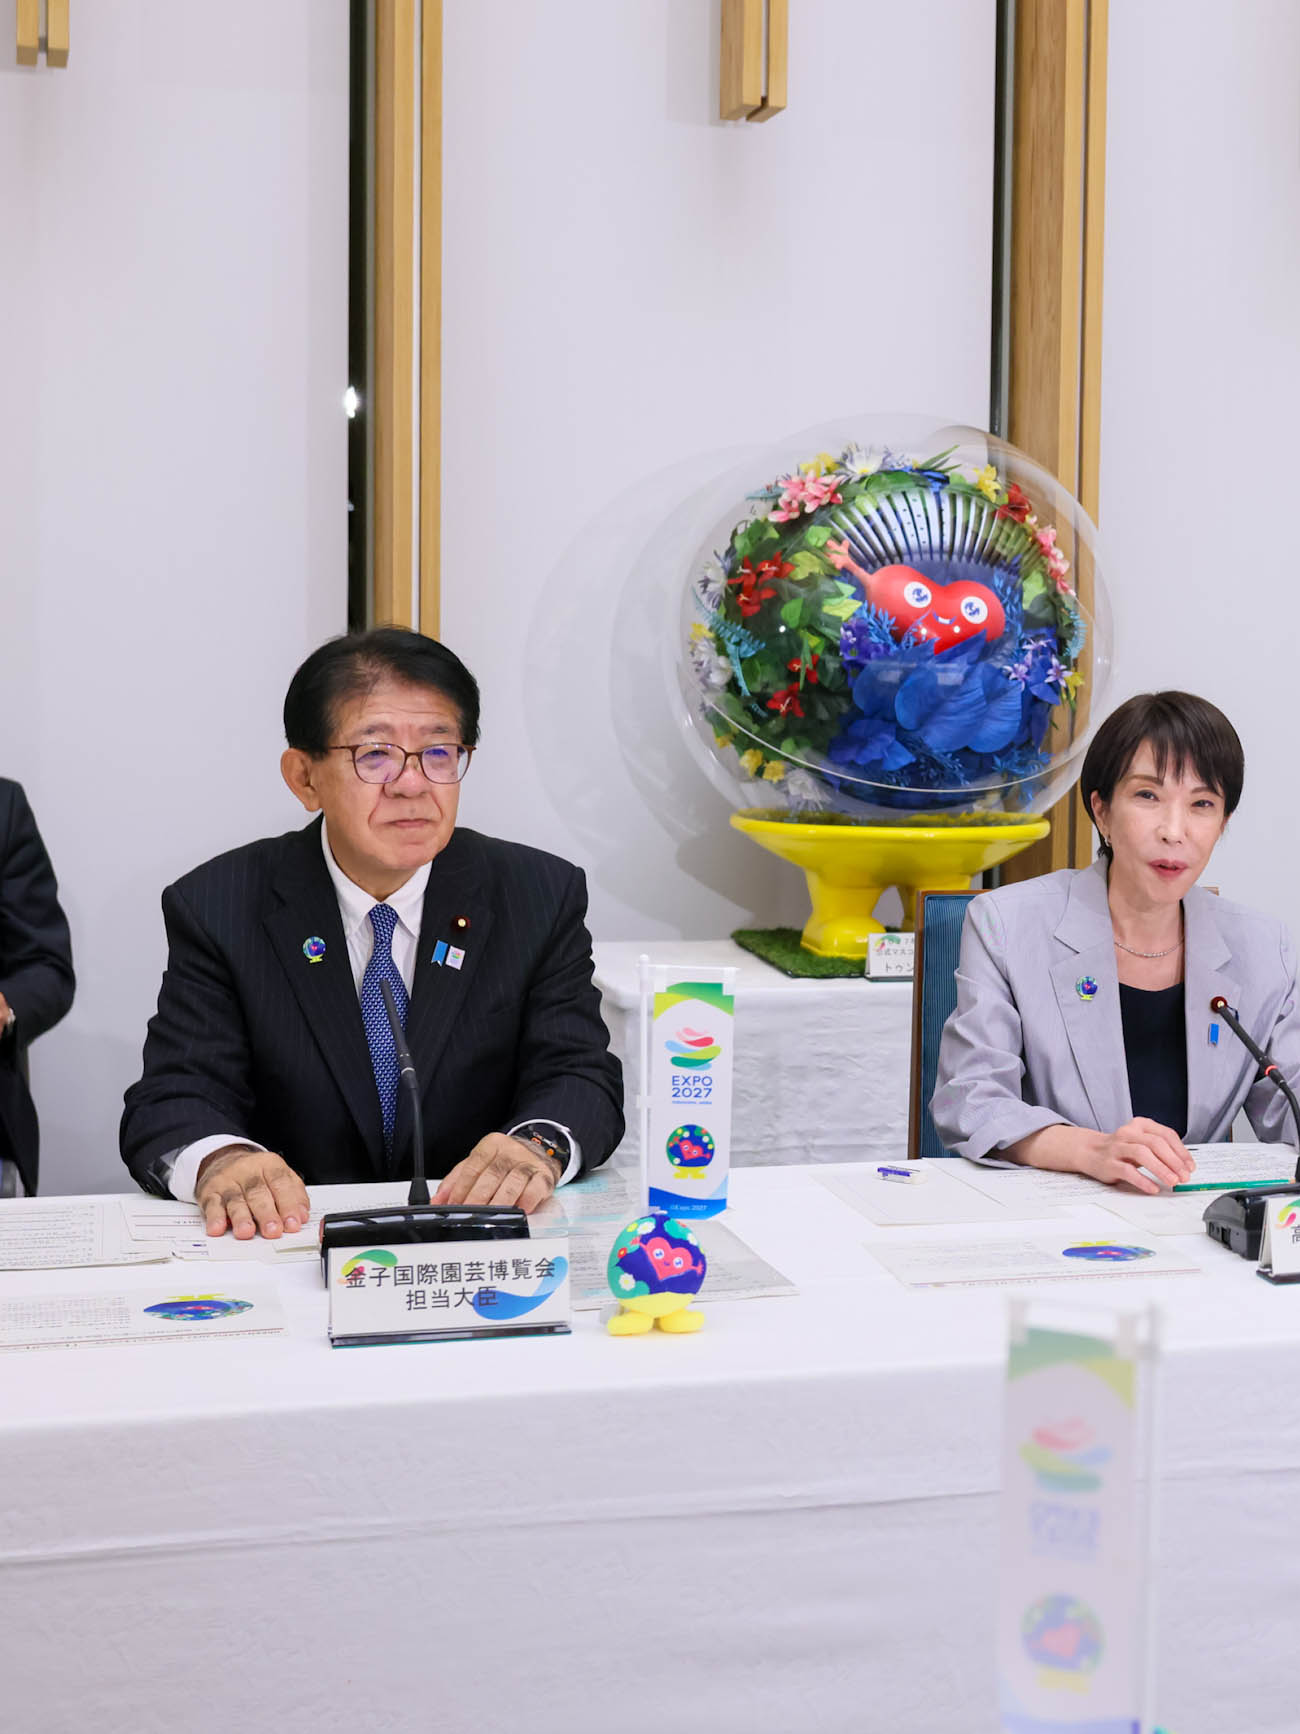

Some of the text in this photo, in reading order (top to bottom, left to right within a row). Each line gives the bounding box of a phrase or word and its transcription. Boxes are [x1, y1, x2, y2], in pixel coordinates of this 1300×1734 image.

[671, 1075, 713, 1087] EXPO
[671, 1087, 713, 1099] 2027
[344, 1256, 556, 1289] 金子国際園芸博覧会
[405, 1285, 499, 1311] 担当大臣
